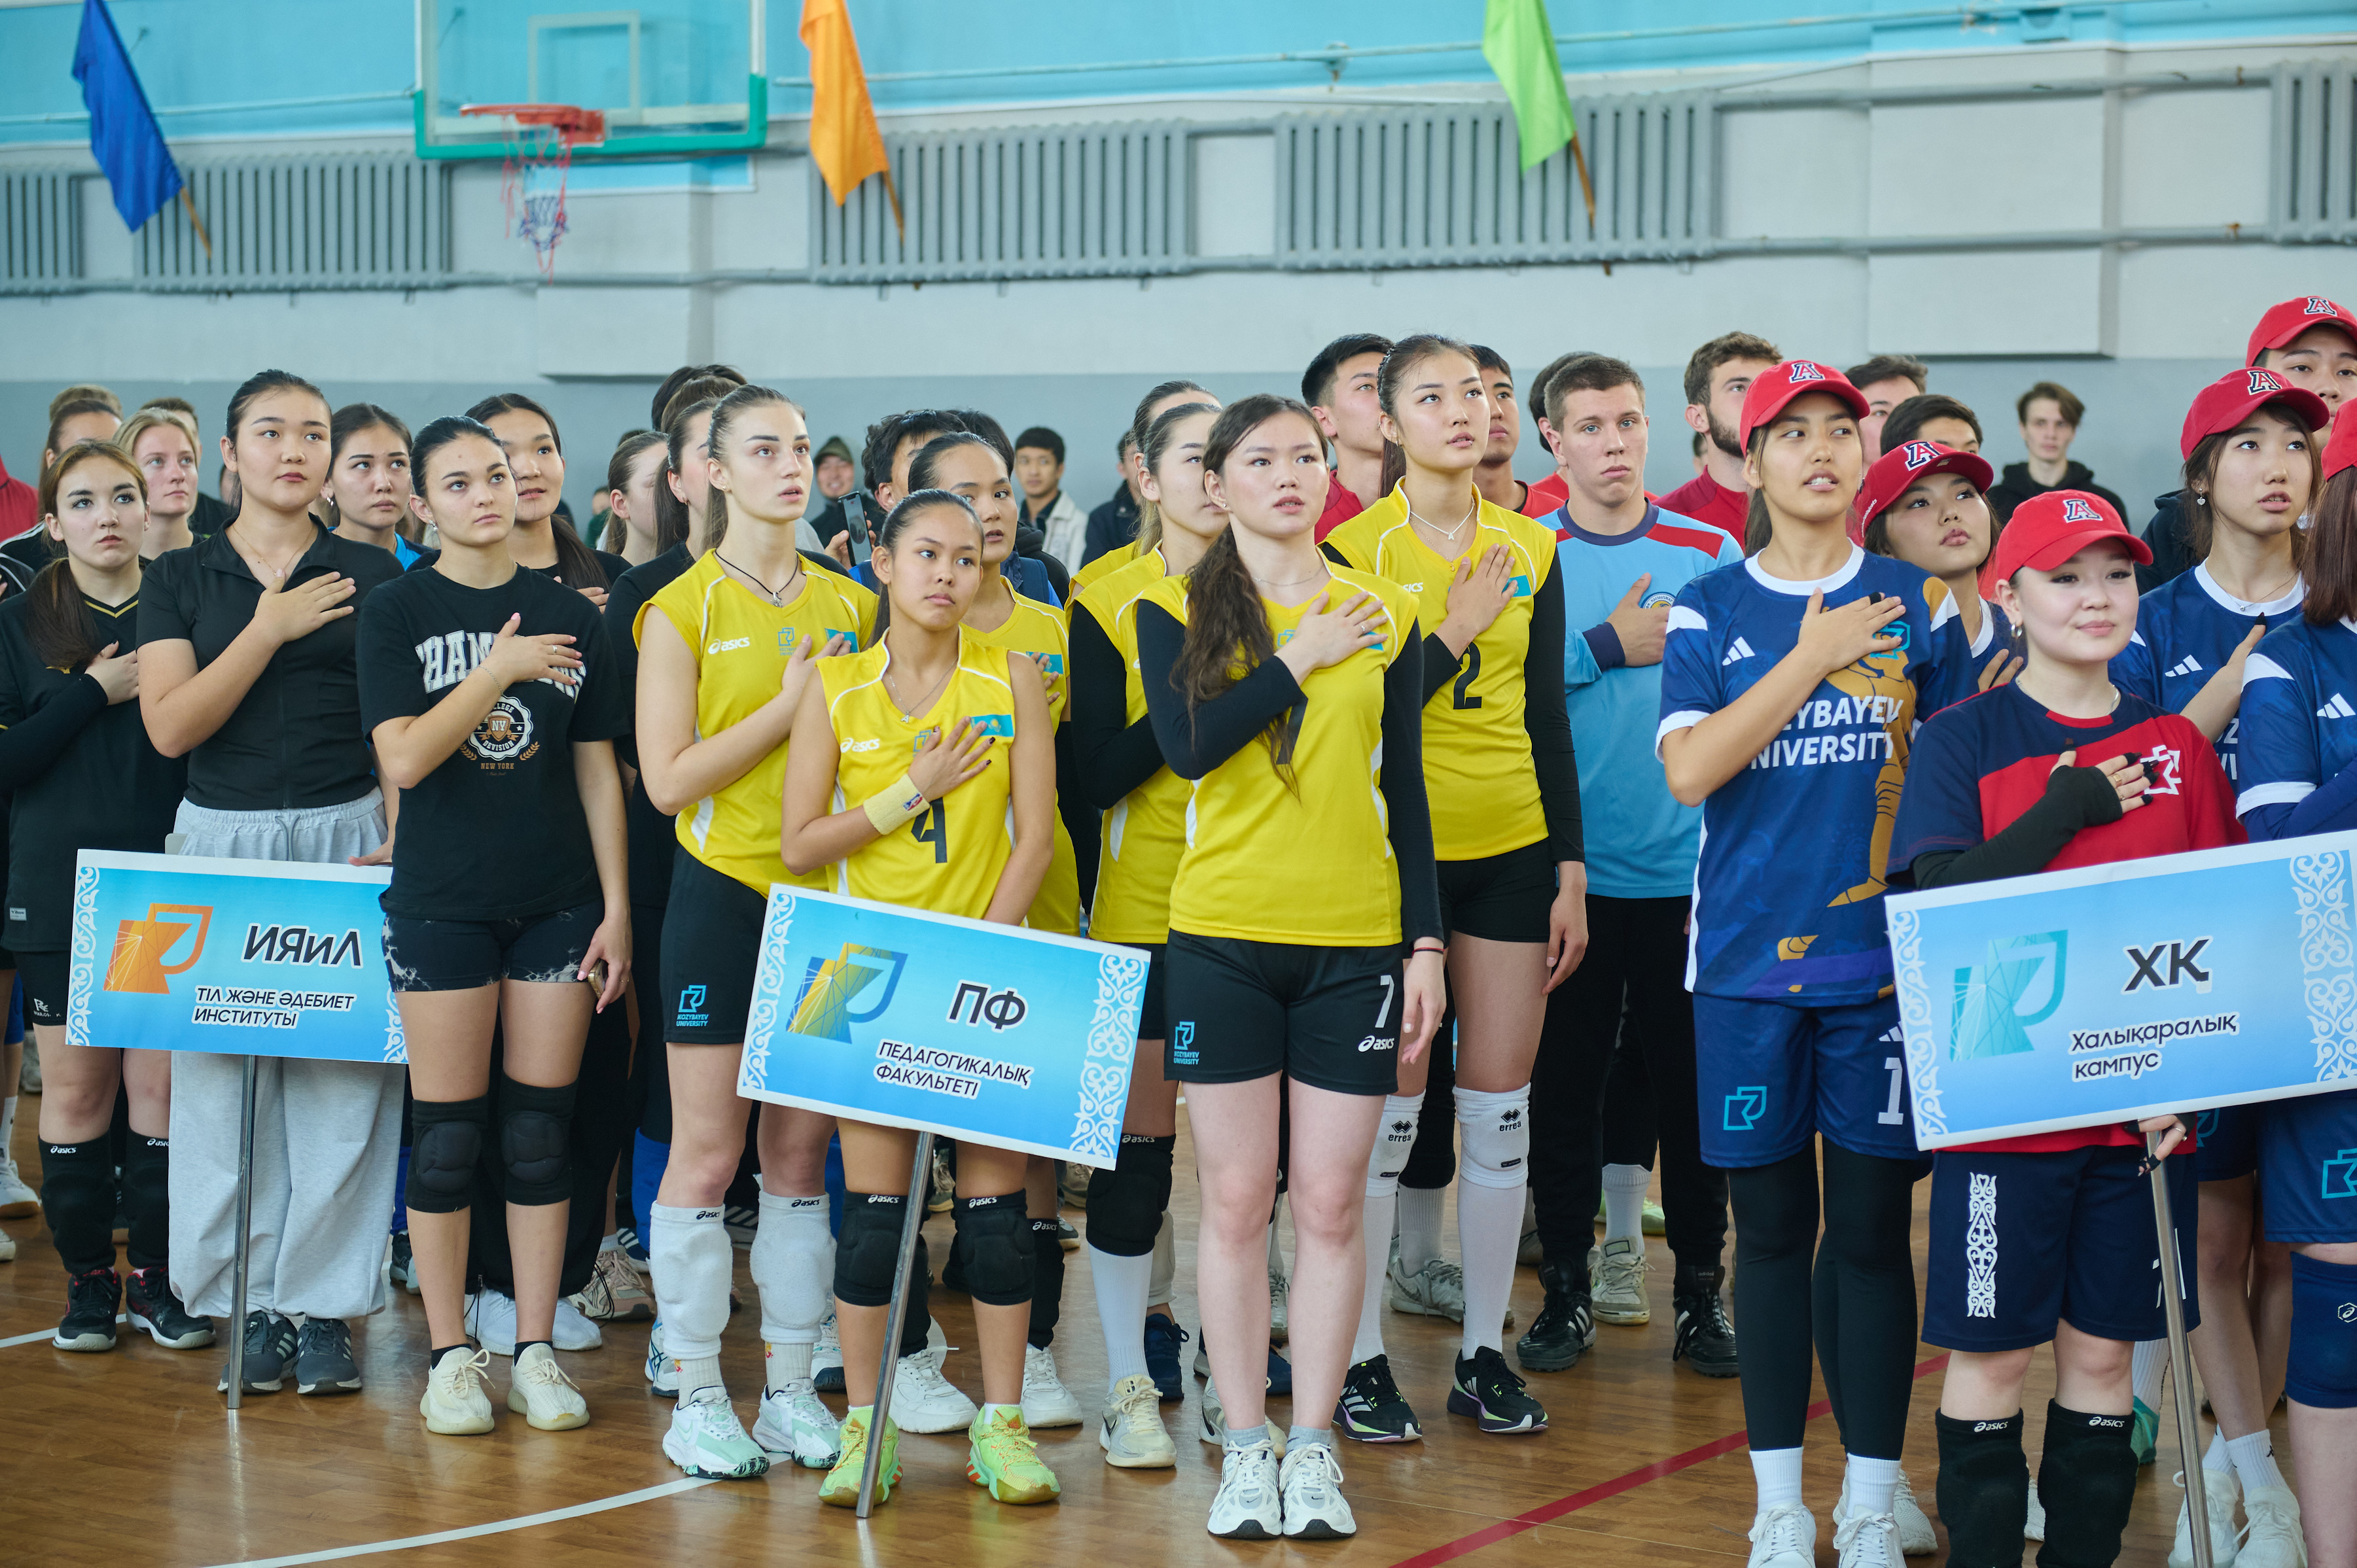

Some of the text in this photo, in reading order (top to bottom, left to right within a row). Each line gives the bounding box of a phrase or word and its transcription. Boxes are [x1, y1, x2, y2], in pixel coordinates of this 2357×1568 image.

[2304, 297, 2338, 317] A
[1789, 362, 1826, 384] A
[2247, 370, 2282, 396] A
[1903, 441, 1943, 472] A
[2063, 498, 2104, 524] A
[720, 636, 751, 652] asics
[1453, 641, 1483, 710] 2
[1781, 695, 1904, 731] YBAYEV
[491, 720, 506, 731] NY
[482, 740, 515, 752] DEVISION
[852, 738, 880, 752] asics
[1750, 731, 1893, 770] NIVERSITY
[911, 797, 948, 864] 4
[243, 925, 361, 967] ИЯиЛ
[196, 987, 355, 1009] ТІЛ ЖӘНЕ ӘДЕБИЕТ
[949, 983, 1026, 1030] ПФ
[1375, 975, 1394, 1028] 7
[194, 1007, 297, 1027] ИНСТИТУТЫ
[1373, 1037, 1395, 1050] asics
[2071, 1015, 2237, 1052] Халықаралық
[879, 1041, 1032, 1086] ПЕДАГОГИКАЛЫҚ
[2075, 1053, 2159, 1079] кампус
[876, 1065, 979, 1096] ФАКУЛЬТЕТІ
[1877, 1057, 1904, 1125] 1
[1499, 1121, 1522, 1132] errea
[1388, 1134, 1412, 1143] errea
[801, 1198, 821, 1207] asics
[877, 1195, 900, 1204] asics
[976, 1196, 998, 1206] asics
[1041, 1223, 1058, 1231] asics
[1985, 1421, 2008, 1431] asics
[2100, 1419, 2125, 1428] asics
